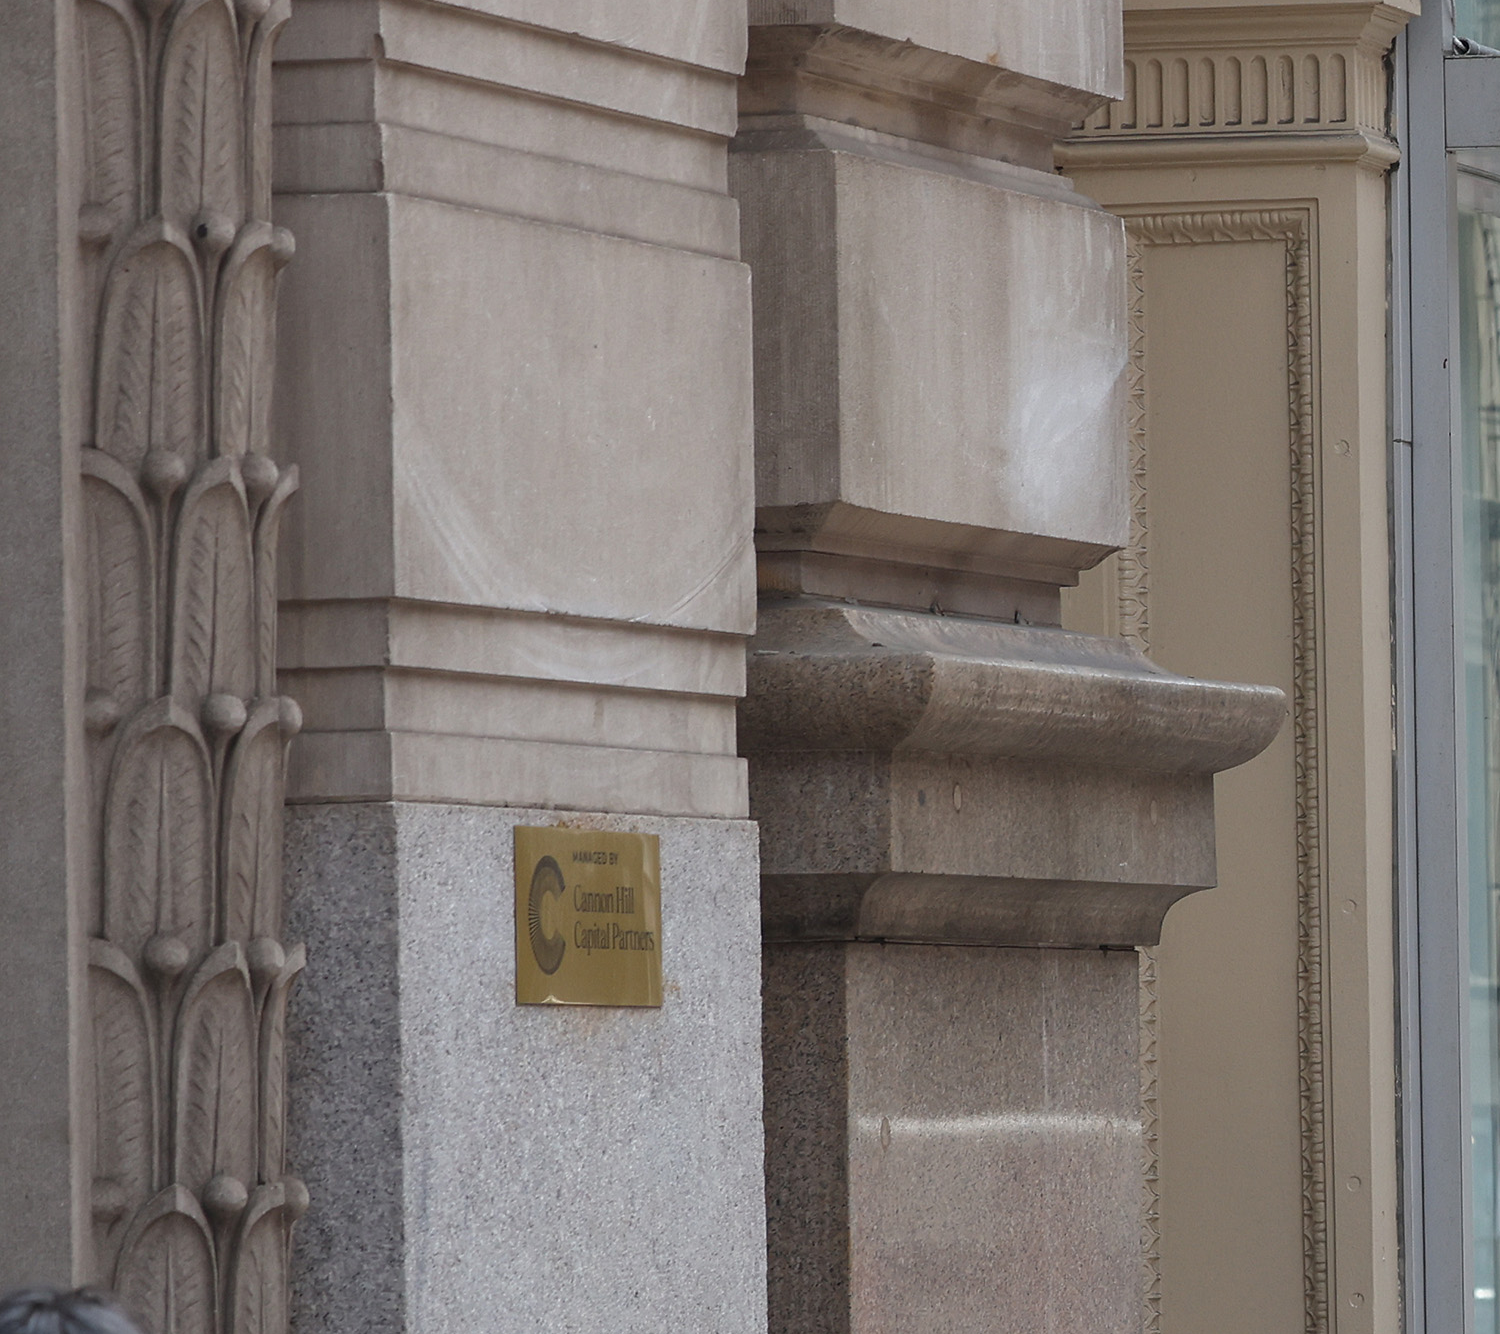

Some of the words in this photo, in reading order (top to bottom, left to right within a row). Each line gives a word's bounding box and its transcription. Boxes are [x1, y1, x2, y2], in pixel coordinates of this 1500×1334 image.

[572, 851, 608, 865] MANAGED
[609, 852, 619, 865] BY
[573, 884, 614, 913] Cannon
[616, 886, 635, 915] Hill
[574, 920, 610, 956] Capital
[612, 923, 655, 952] Partners
